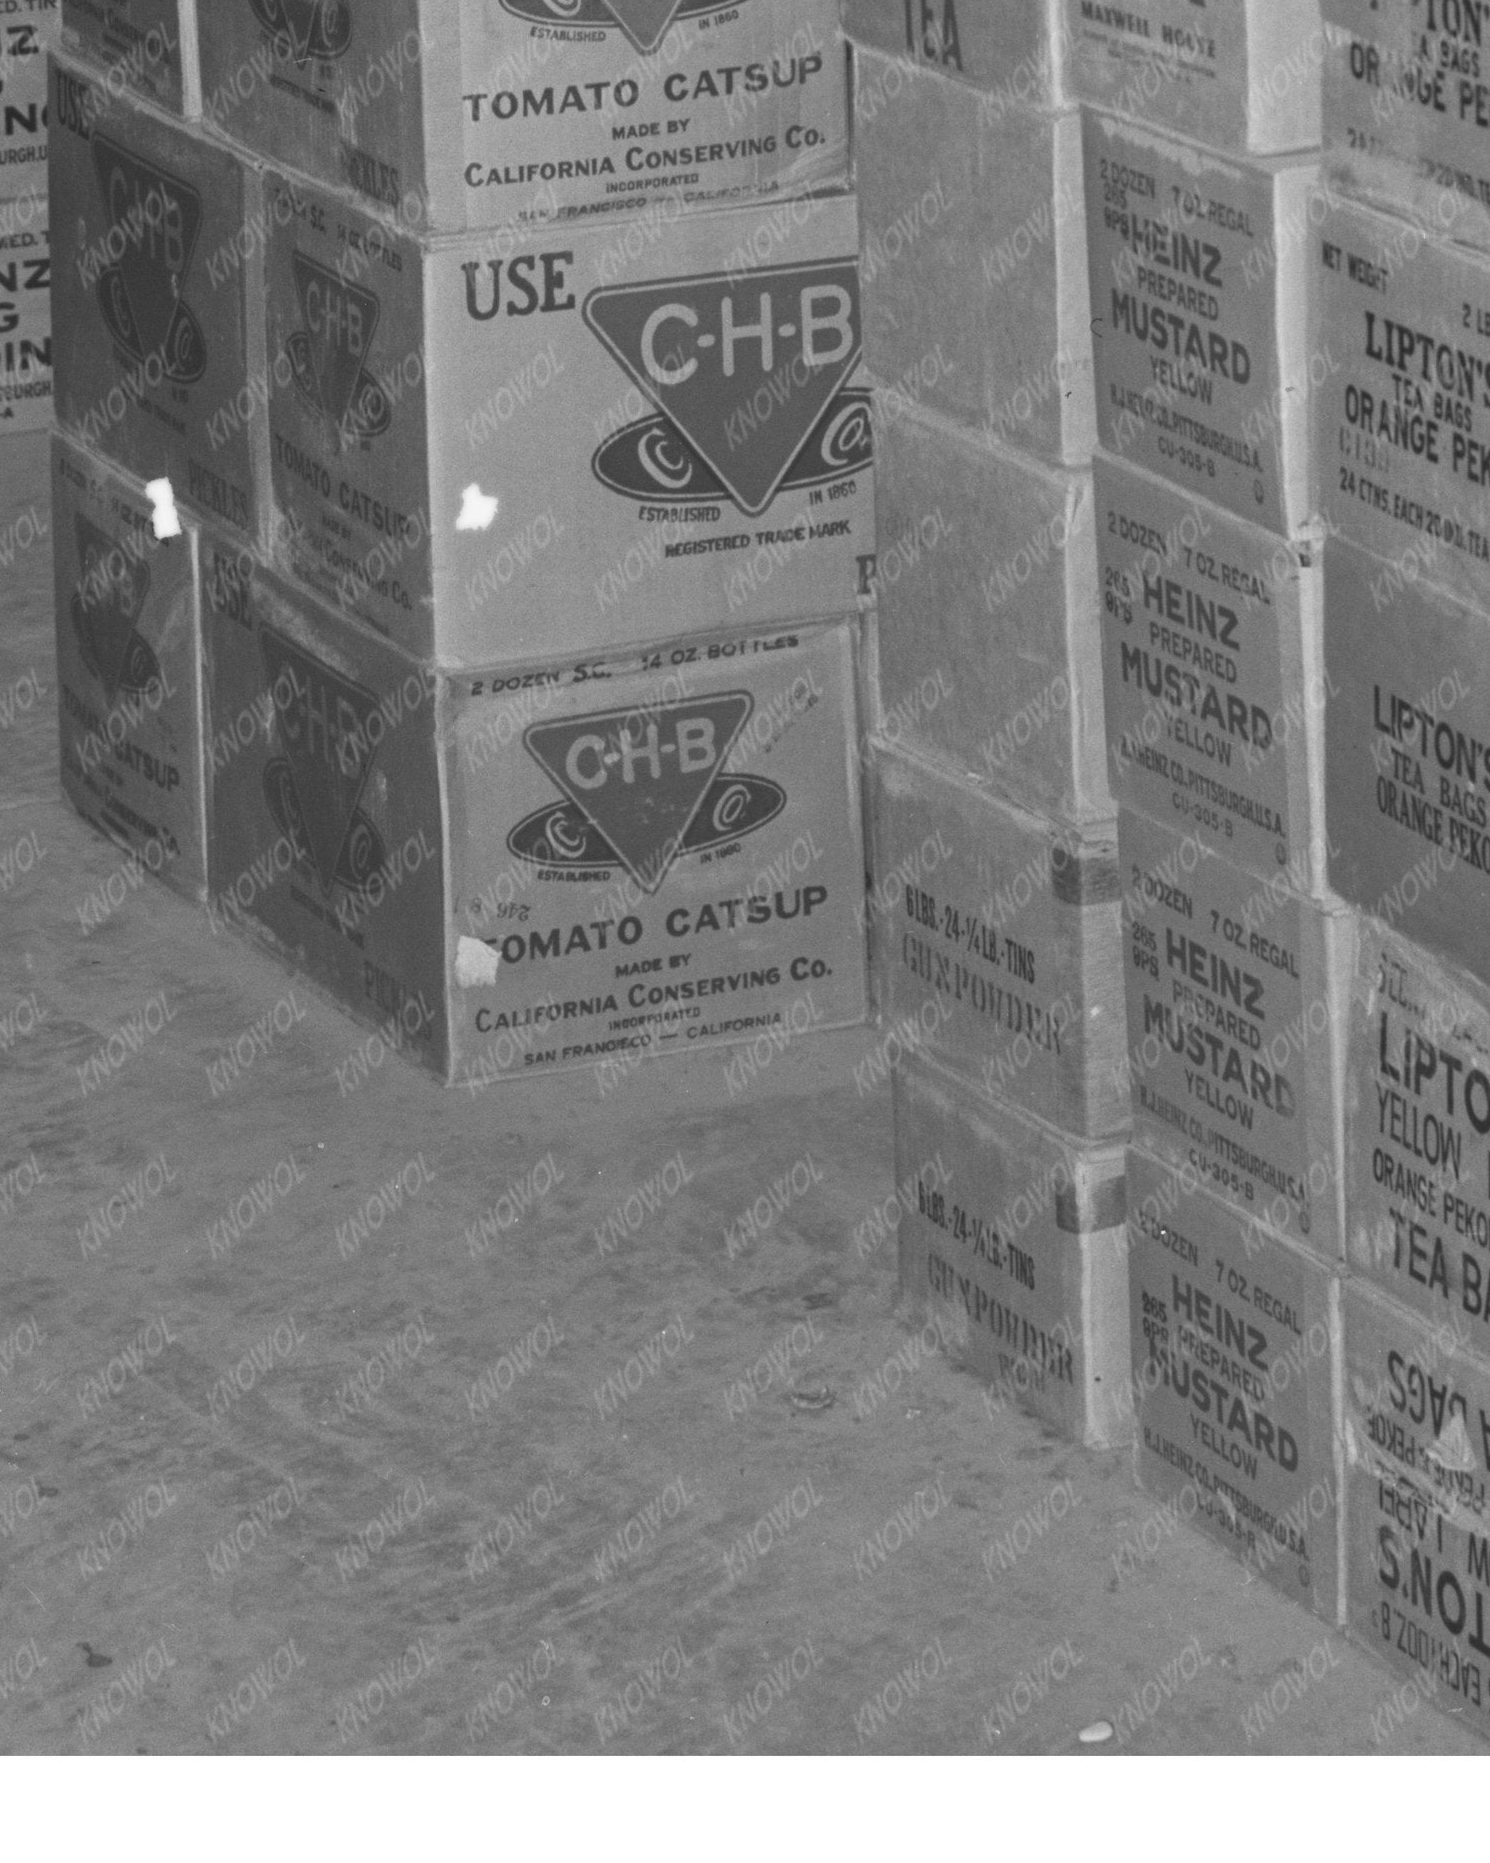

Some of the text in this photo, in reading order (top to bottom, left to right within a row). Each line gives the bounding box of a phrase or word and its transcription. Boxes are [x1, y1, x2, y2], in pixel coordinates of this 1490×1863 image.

[462, 54, 823, 123] TOMATO CATSUP
[464, 137, 778, 187] CALIFORNIA CONSERVING
[611, 117, 690, 141] MADE BY
[1132, 220, 1223, 289] HEINZ
[1111, 289, 1251, 387] MUSTARD
[1142, 995, 1295, 1118] MUSTARD
[1185, 1070, 1254, 1131] YELLOW
[1388, 1209, 1452, 1297] TEA
